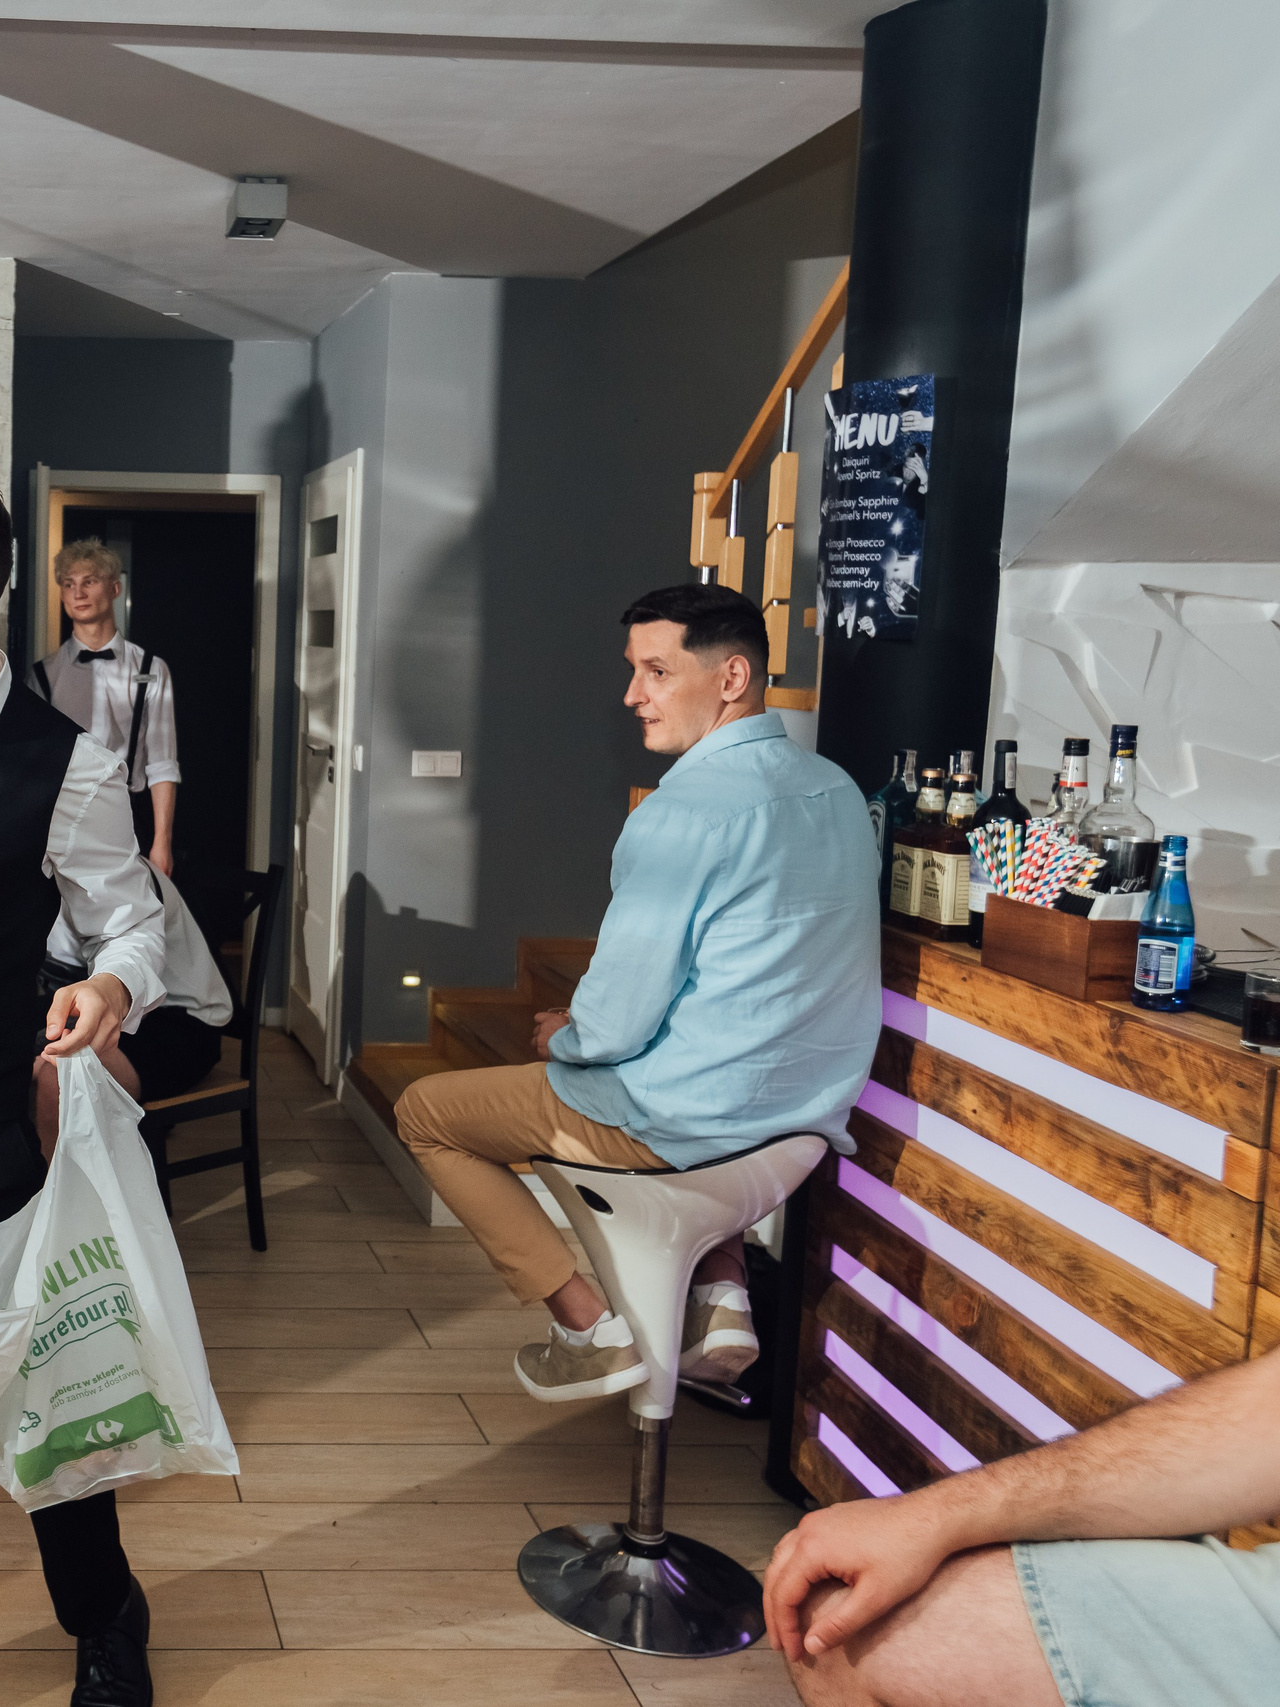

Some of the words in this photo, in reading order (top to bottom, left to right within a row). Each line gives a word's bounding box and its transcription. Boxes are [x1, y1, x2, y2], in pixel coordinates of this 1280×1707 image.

[834, 412, 899, 452] MENU
[855, 468, 881, 482] Spritz
[858, 495, 899, 509] Sapphire
[862, 510, 893, 522] Honey
[846, 537, 885, 548] Prosecco
[843, 551, 881, 562] Prosecco
[842, 578, 879, 591] semi-dry
[41, 1236, 125, 1304] NLINE
[31, 1290, 132, 1357] arrefour.pl
[92, 1363, 124, 1384] sklepie
[66, 1388, 97, 1403] zamów
[104, 1368, 140, 1388] dostawą
